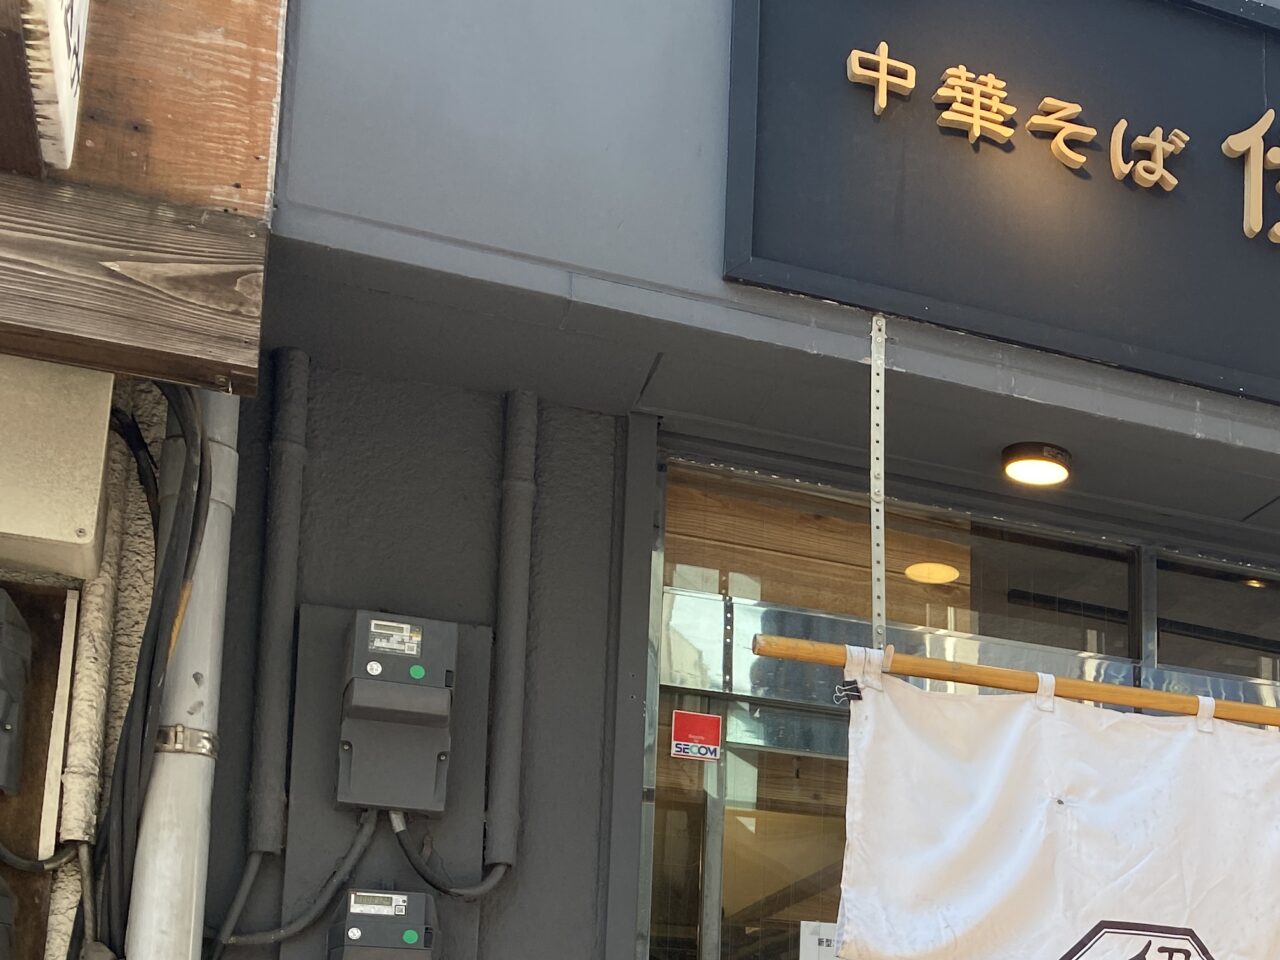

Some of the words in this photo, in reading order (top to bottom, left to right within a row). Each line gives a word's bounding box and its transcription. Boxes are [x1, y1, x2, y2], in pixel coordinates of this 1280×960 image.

[846, 41, 1190, 191] 中華そば
[675, 743, 717, 757] SECOM
